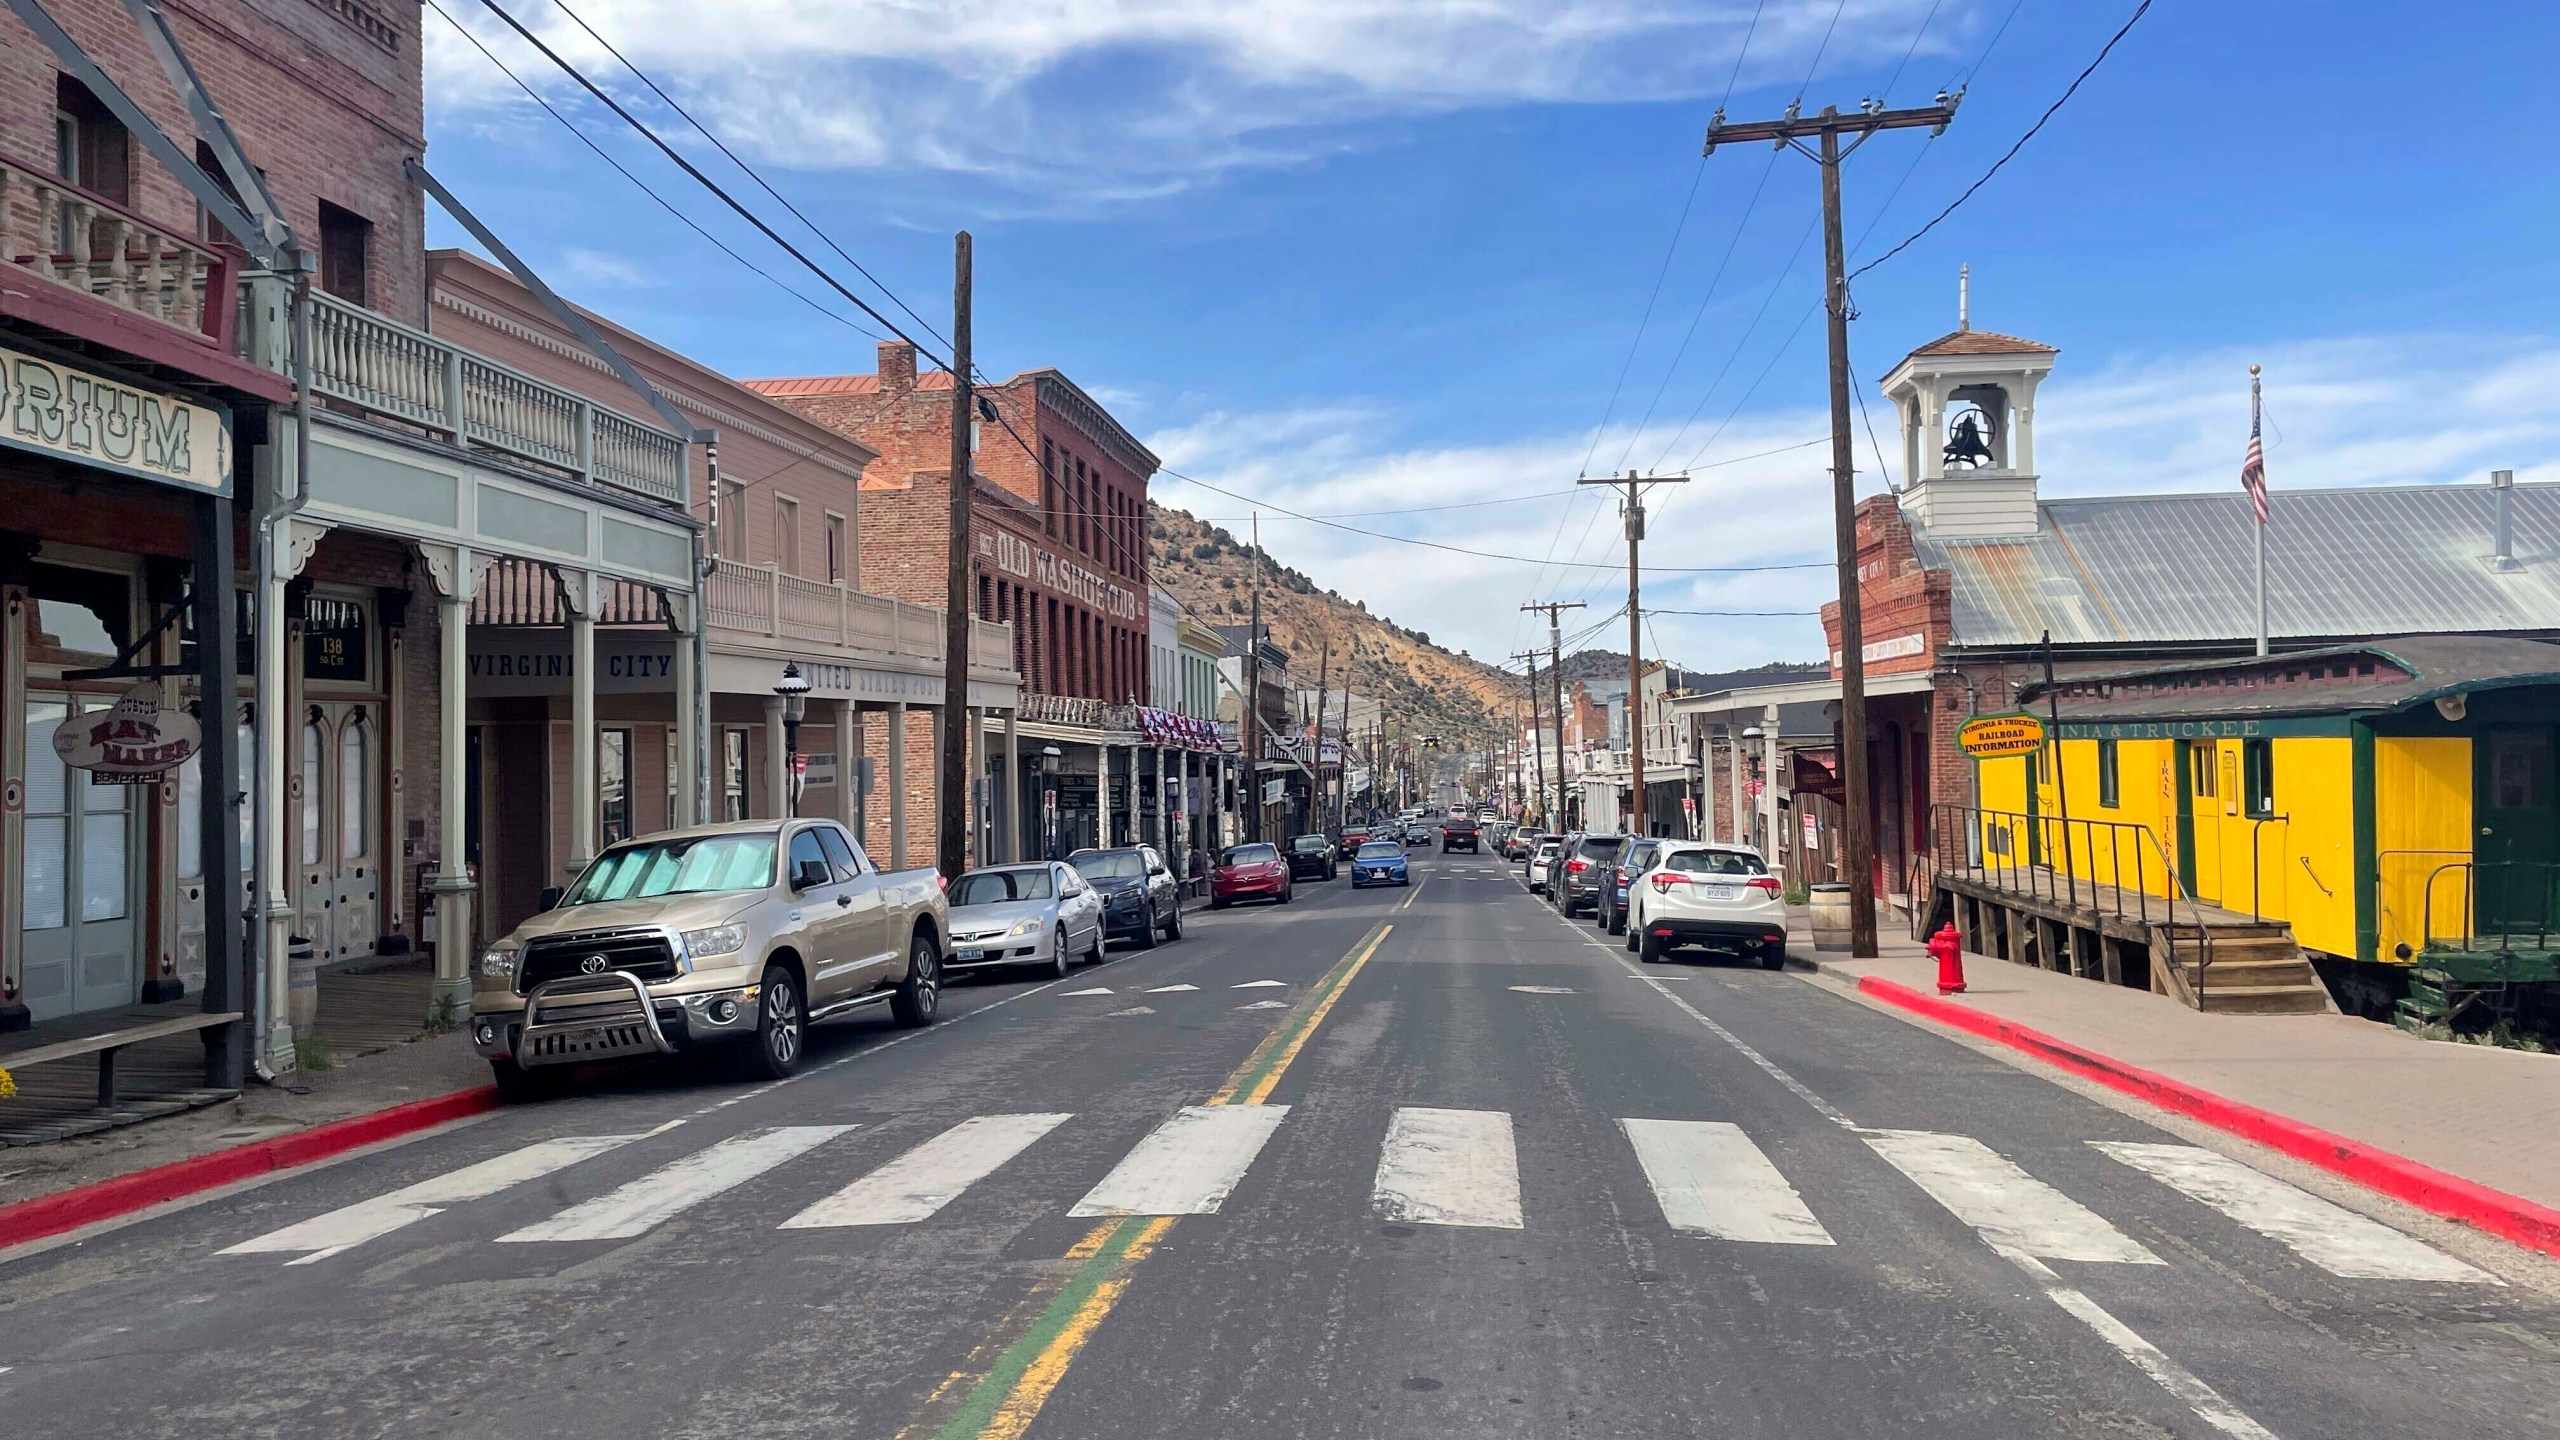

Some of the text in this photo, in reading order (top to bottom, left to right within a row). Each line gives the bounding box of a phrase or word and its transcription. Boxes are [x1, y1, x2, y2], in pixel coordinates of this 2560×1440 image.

[0, 356, 190, 474] RIUM
[998, 530, 1030, 578] OLD
[1033, 546, 1106, 611] WASHOE
[1106, 583, 1136, 621] CLUB
[323, 637, 342, 654] 138
[330, 655, 336, 666] C
[468, 655, 671, 677] VIRGINI CITY
[800, 662, 851, 691] NITED
[860, 669, 906, 694] STATES
[1963, 720, 1996, 735] VIRGINIA
[2005, 719, 2038, 728] TRUCKEE
[1979, 729, 2025, 740] RAILROAD
[2047, 720, 2260, 738] GINIA & TRUCKEE
[1965, 738, 2040, 753] INFORMATION
[2162, 760, 2170, 798] TRAIN
